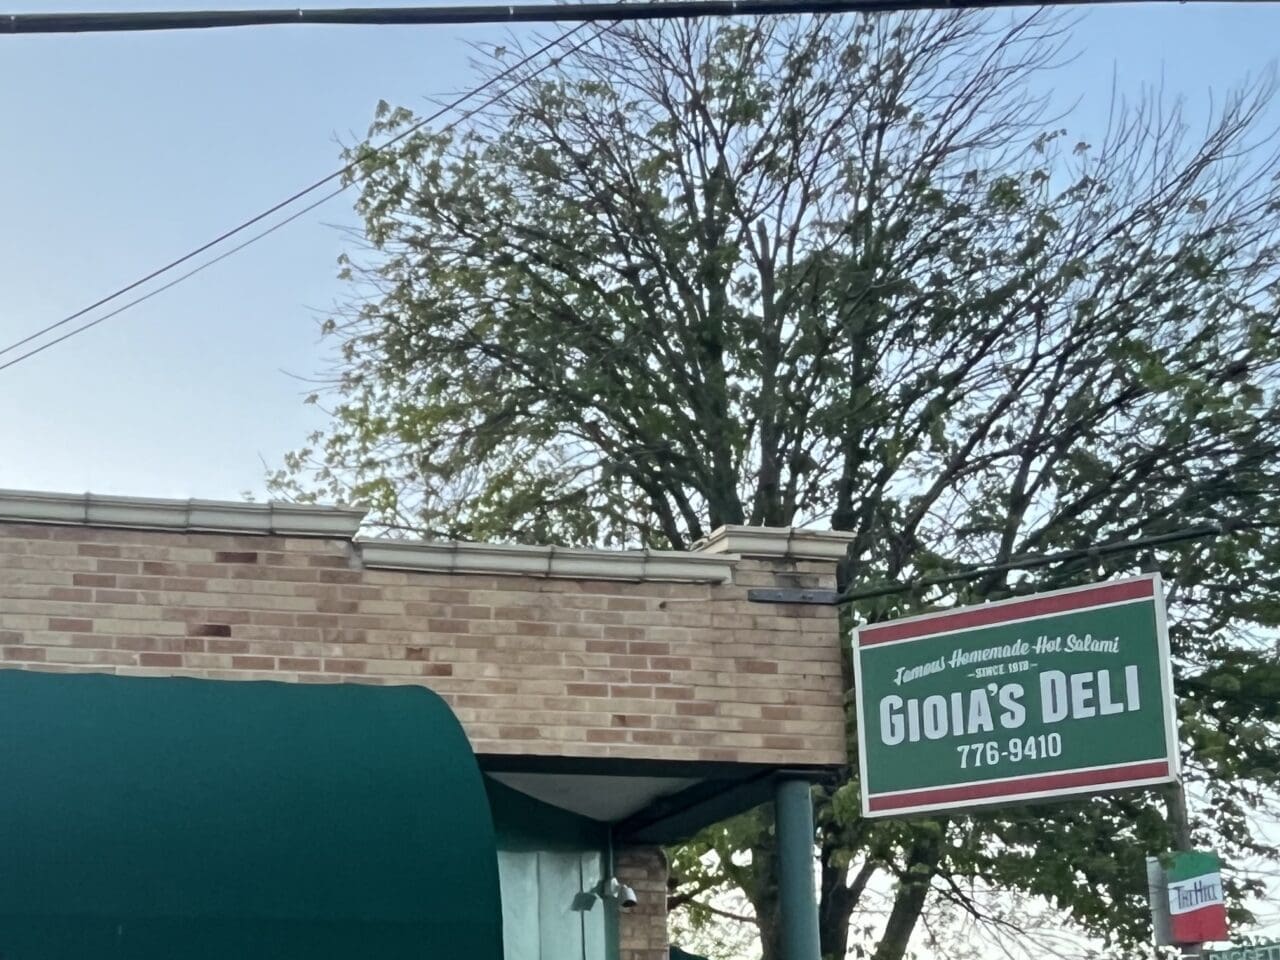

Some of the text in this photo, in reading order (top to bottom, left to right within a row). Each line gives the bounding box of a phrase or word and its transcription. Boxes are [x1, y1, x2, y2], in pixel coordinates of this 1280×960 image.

[893, 633, 1120, 686] Famous Homemade Hot Salami
[975, 664, 1005, 679] SINCE
[879, 665, 1141, 746] GIOIA'S DELI
[957, 732, 1062, 769] 776-9410
